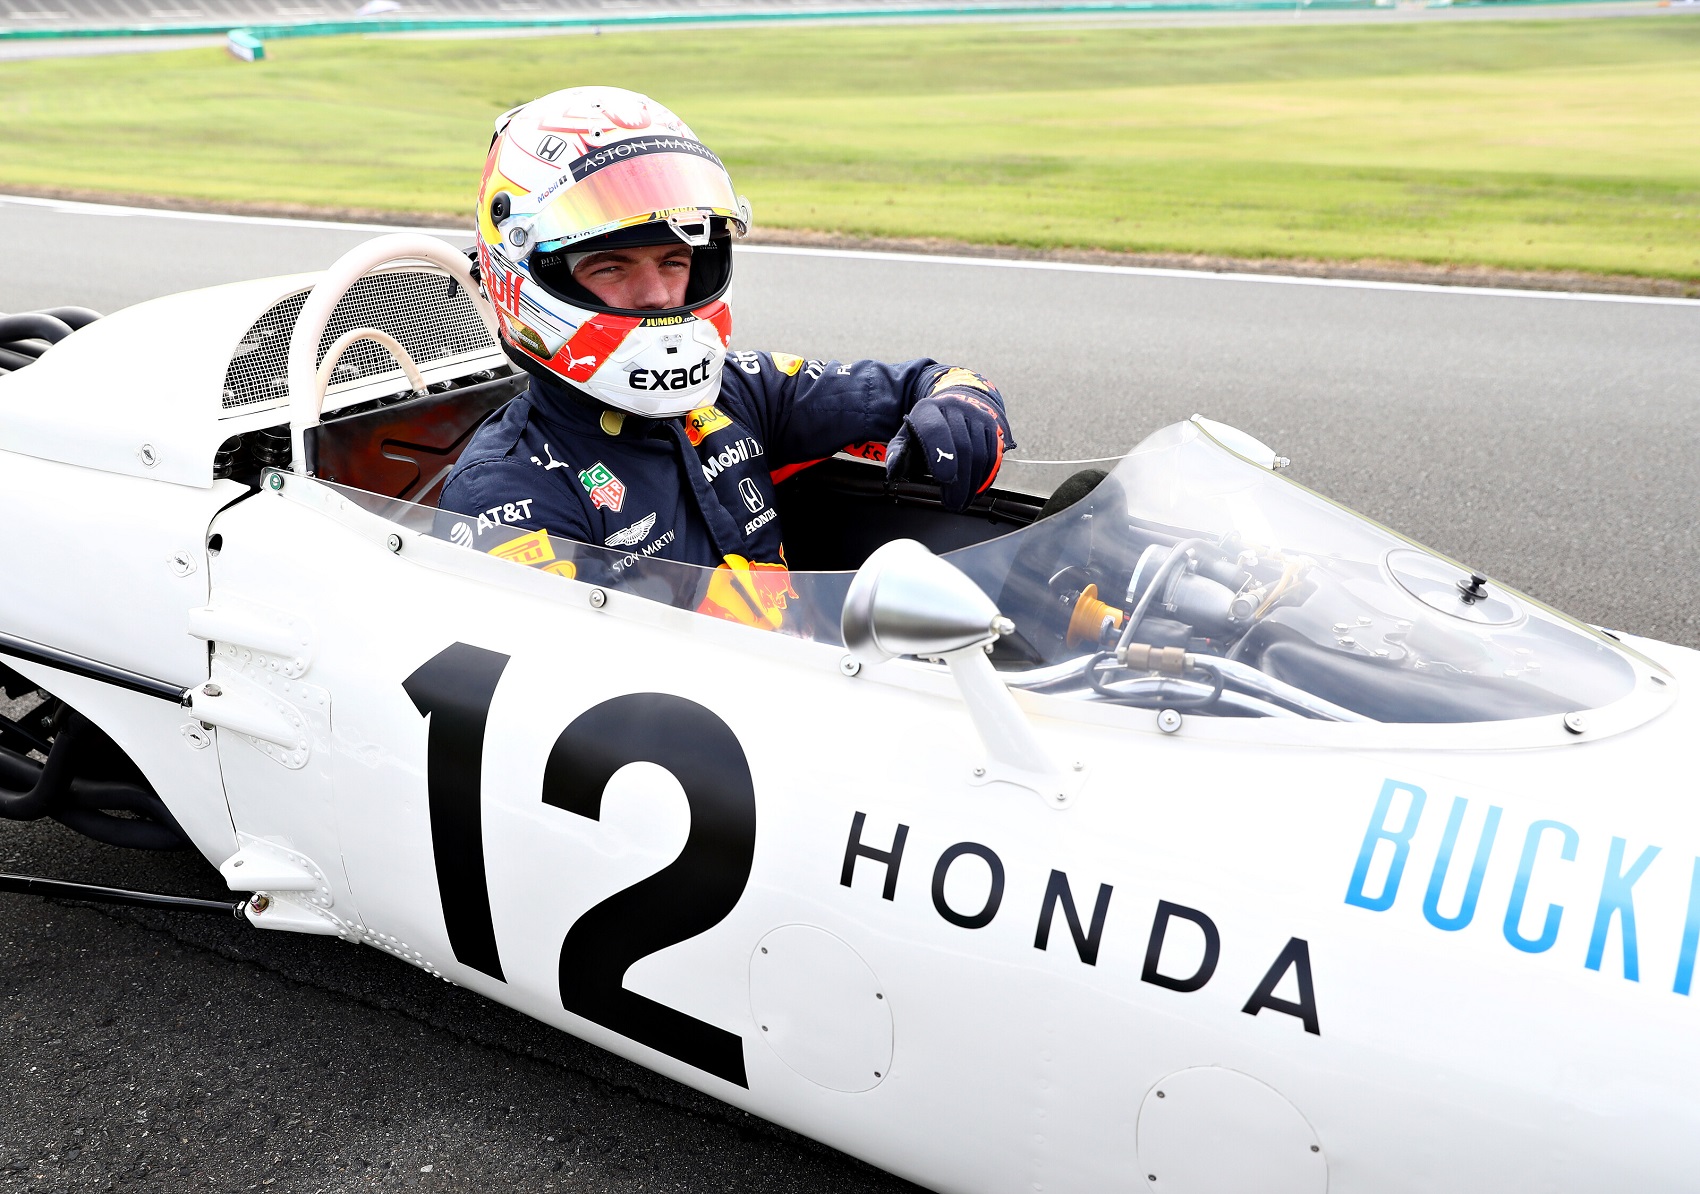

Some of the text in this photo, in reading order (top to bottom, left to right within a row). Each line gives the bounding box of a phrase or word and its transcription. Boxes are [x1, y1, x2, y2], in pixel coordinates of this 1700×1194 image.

[584, 141, 648, 172] ASTON
[537, 181, 559, 203] Mobil
[629, 357, 710, 391] exact
[732, 350, 761, 375] cit
[691, 408, 725, 432] RAUC
[701, 439, 749, 483] Mobil
[477, 499, 533, 536] AT&T
[612, 551, 640, 573] STON
[401, 641, 757, 1090] 12
[840, 811, 1321, 1036] HONDA
